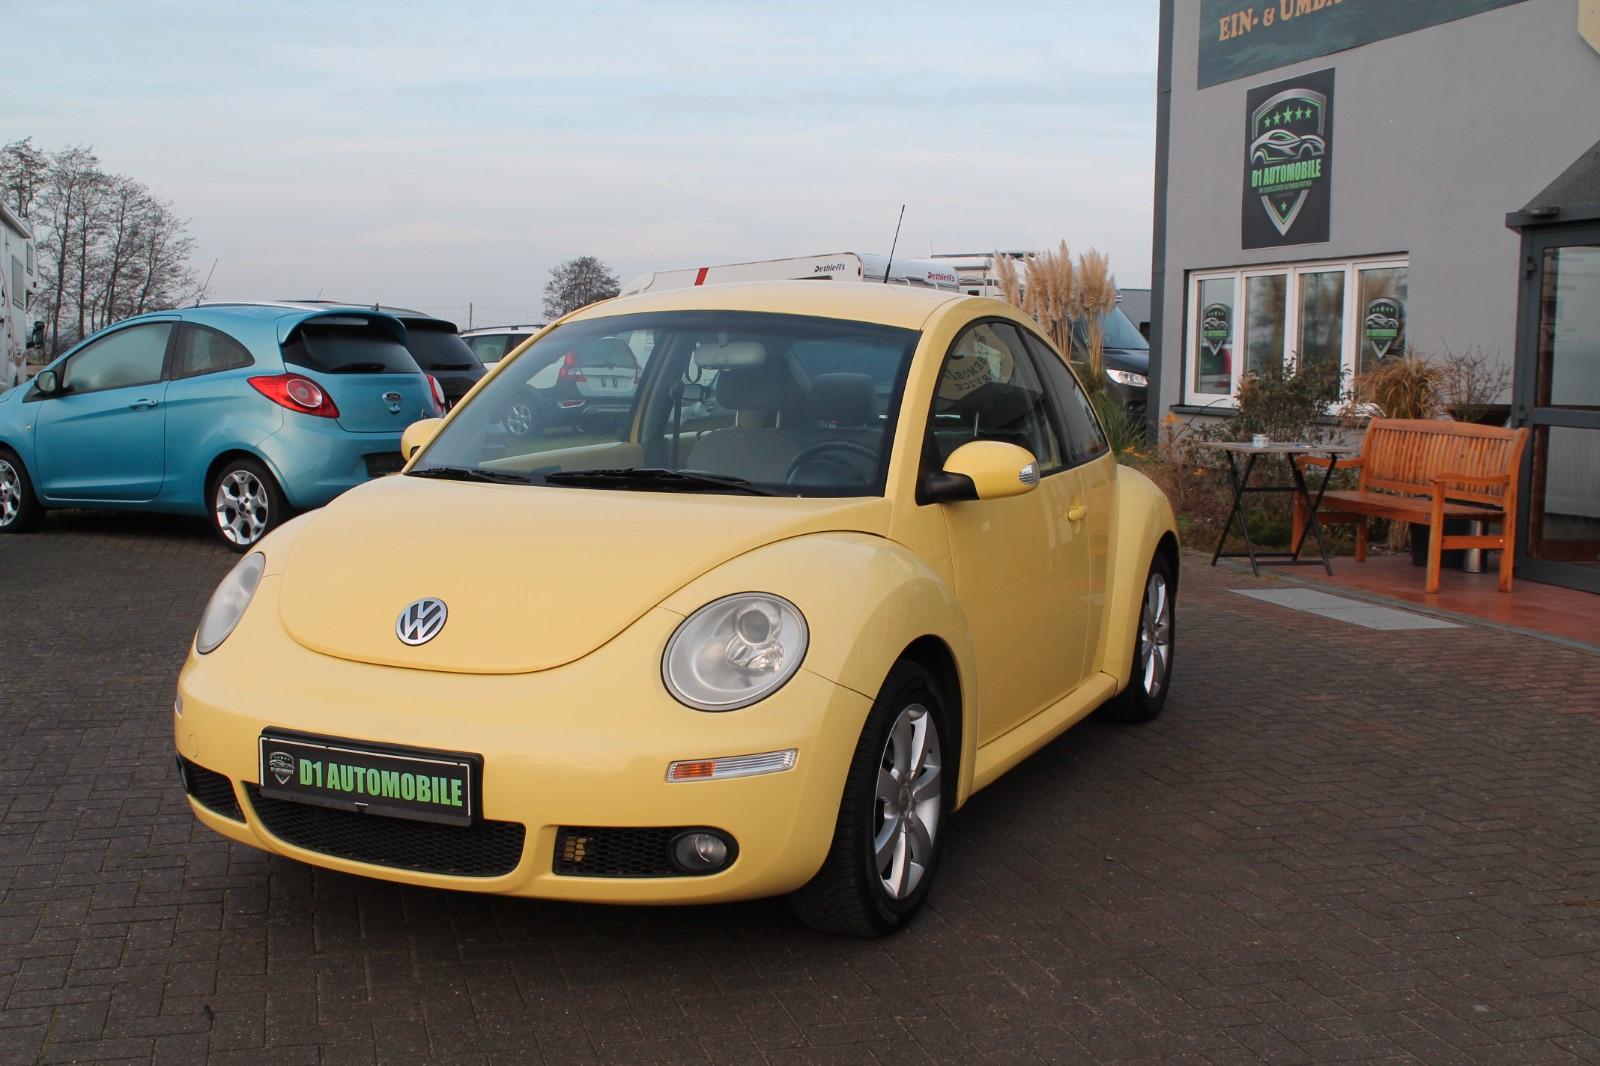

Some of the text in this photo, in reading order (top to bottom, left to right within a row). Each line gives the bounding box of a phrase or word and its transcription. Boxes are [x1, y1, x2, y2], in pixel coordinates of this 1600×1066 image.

[1218, 8, 1259, 41] EIN-
[1263, 7, 1275, 27] &
[1251, 168, 1263, 188] D1
[1263, 159, 1321, 186] AUTOMOBILE
[397, 598, 447, 645] VW
[300, 758, 463, 807] D1 AUTOMOBILE
